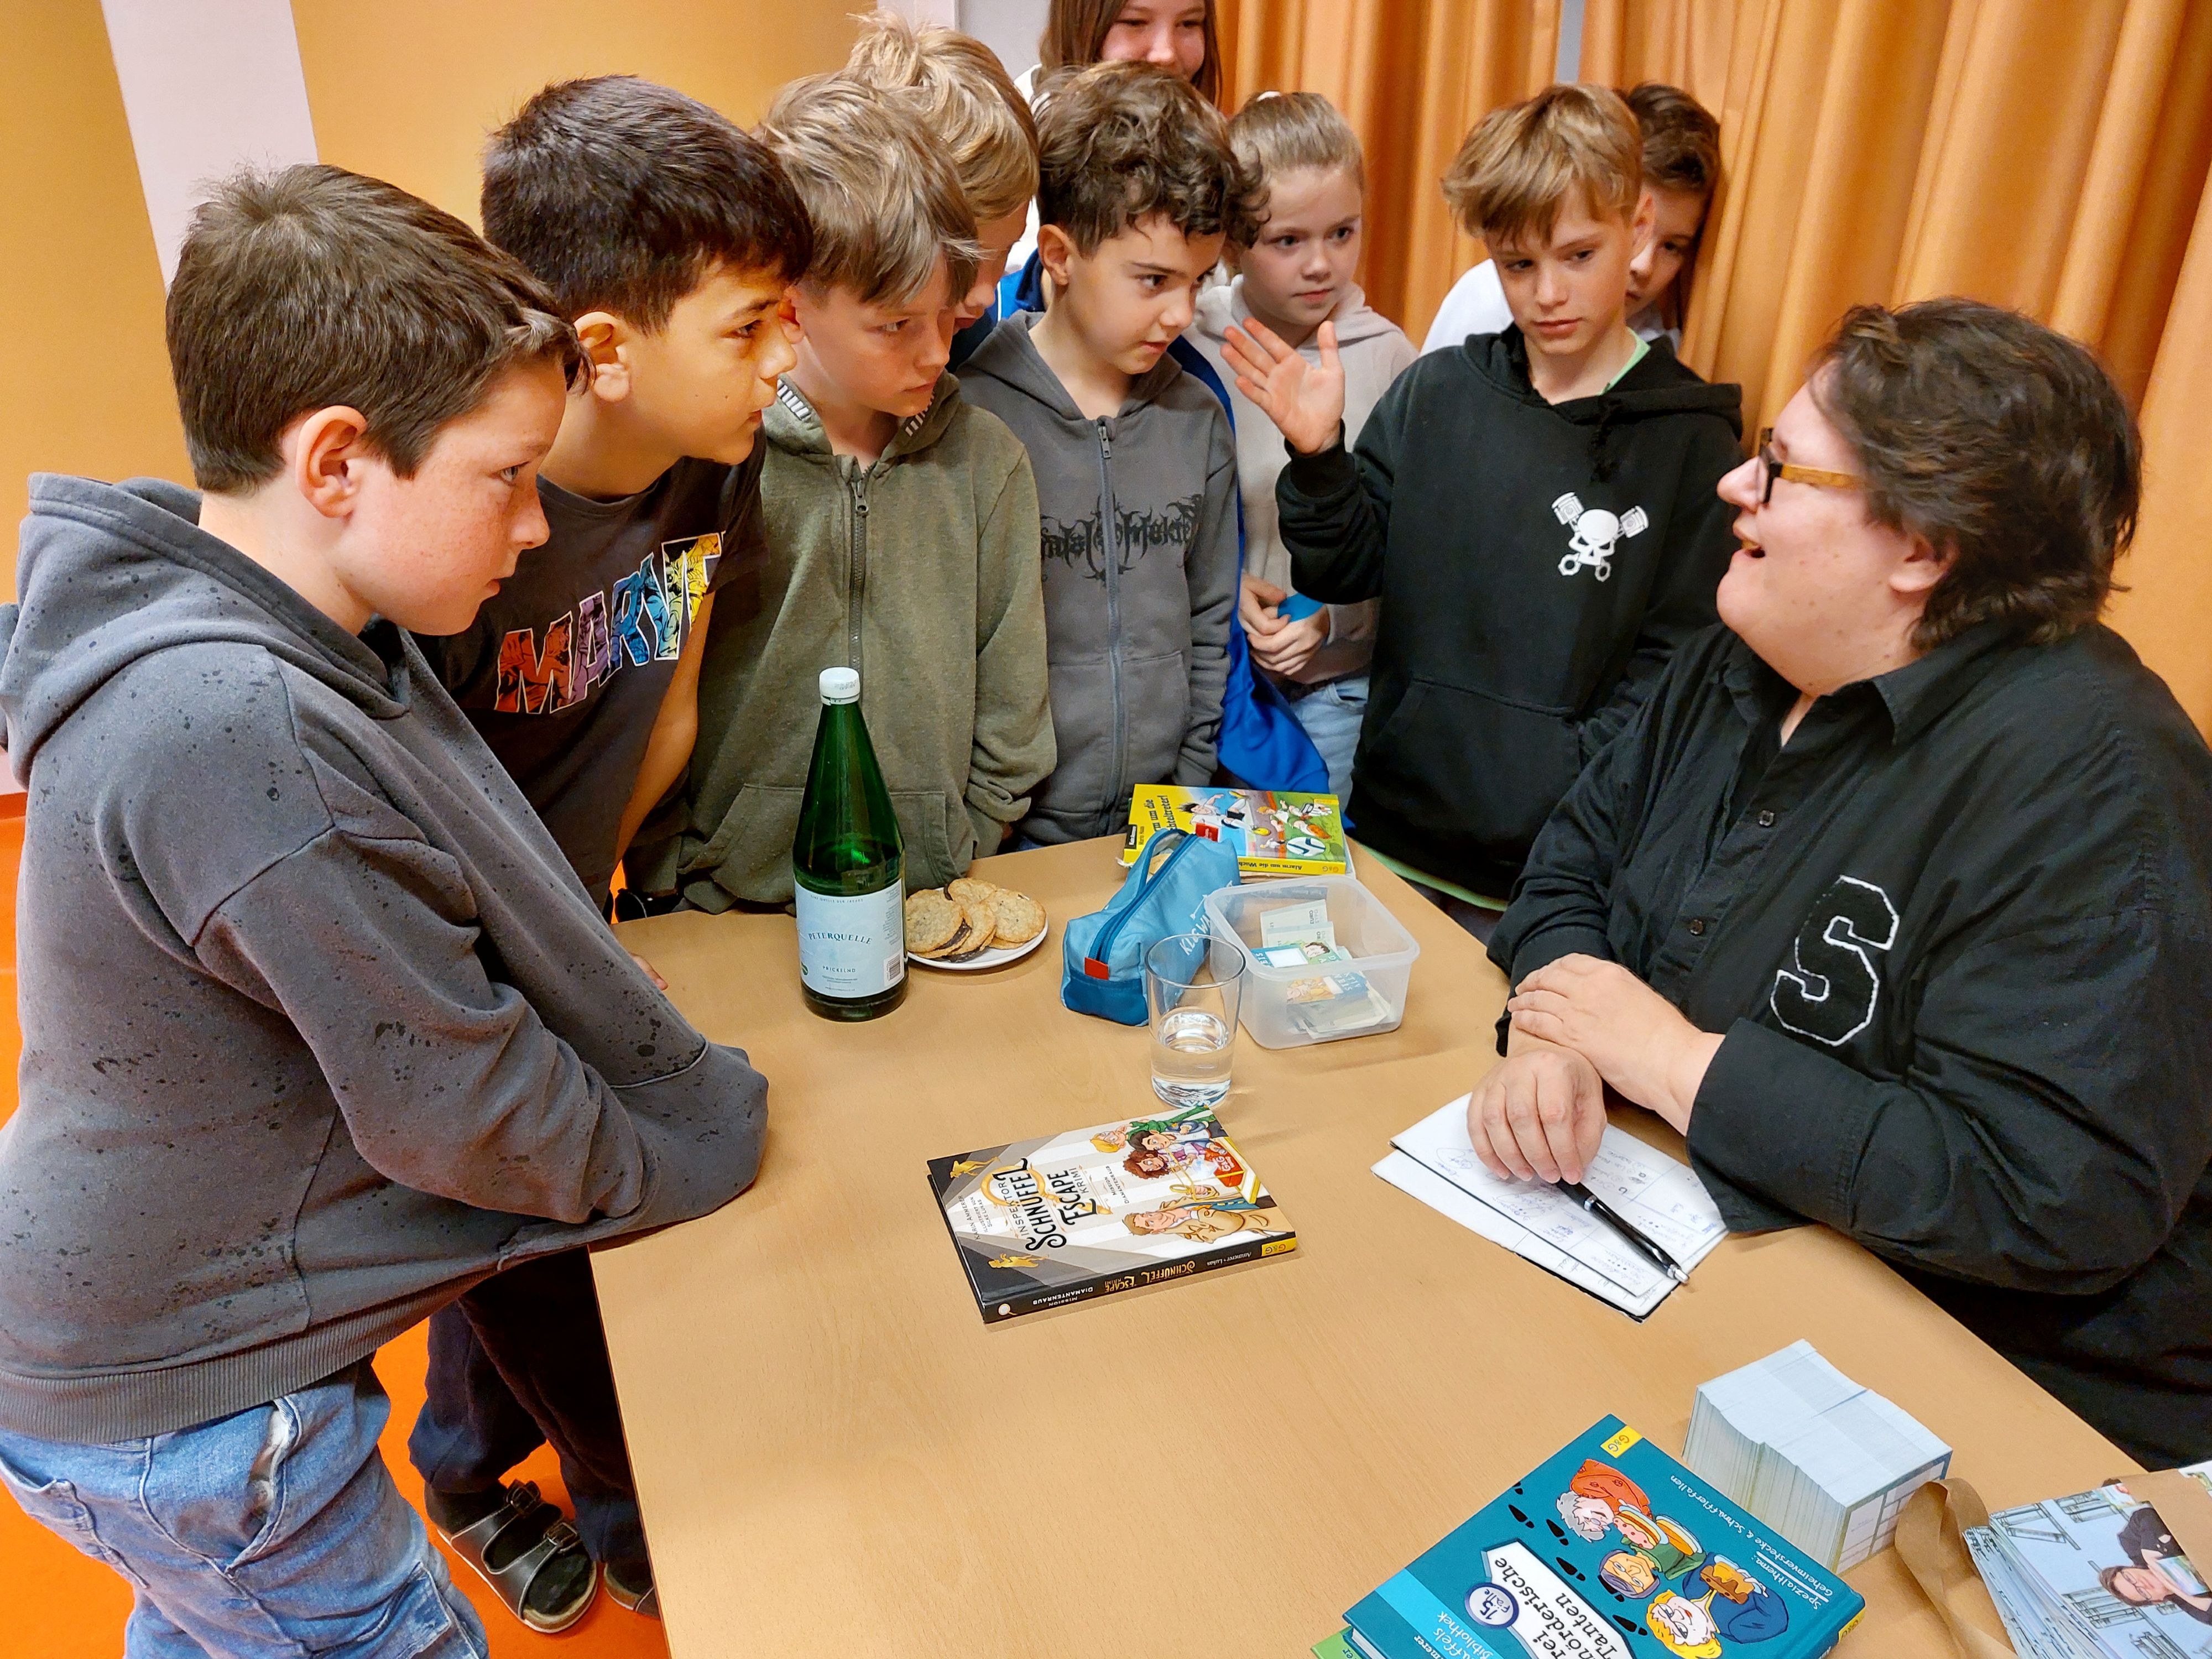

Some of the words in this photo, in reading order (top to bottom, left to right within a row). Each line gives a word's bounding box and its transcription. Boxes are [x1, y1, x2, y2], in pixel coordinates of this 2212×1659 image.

[494, 530, 727, 714] MARV
[1144, 800, 1155, 808] die
[1157, 795, 1177, 829] hteltreter!
[1149, 810, 1158, 820] um
[808, 932, 873, 945] PETERQUELLE
[822, 965, 856, 973] PRICKELND
[1770, 874, 1900, 1046] S
[1069, 1167, 1089, 1194] KRIMI
[1104, 1176, 1118, 1196] MISSION
[1105, 1165, 1130, 1204] DIAMANTENRAUB
[977, 1199, 987, 1214] LUKAS
[992, 1158, 1067, 1251] SCHNÜFFEL
[1046, 1170, 1098, 1225] ESCAPE
[958, 1195, 973, 1221] AMMERER
[998, 1182, 1030, 1236] INSPEKTOR
[974, 1207, 989, 1233] ILLUSTRIERT
[984, 1214, 993, 1227] SILKE
[970, 1222, 981, 1240] KARIN
[1227, 1251, 1252, 1262] Ammerer
[1265, 1243, 1286, 1254] G&G
[1207, 1258, 1223, 1266] Lukas
[1105, 1276, 1135, 1293] ESCAPE
[1032, 1286, 1093, 1305] DIAMANTENRAUB
[1048, 1296, 1078, 1307] MISSION
[1608, 1434, 1630, 1452] G&G
[1746, 1529, 1755, 1539] &
[1754, 1536, 1834, 1597] Geheimverstecke
[1751, 1554, 1822, 1610] Spezialthema:
[1479, 1600, 1498, 1620] 15
[1484, 1588, 1511, 1614] Fälle
[1437, 1610, 1494, 1659] Bibliothek
[1554, 1592, 1618, 1659] Tanten
[1413, 1635, 1444, 1659] merer
